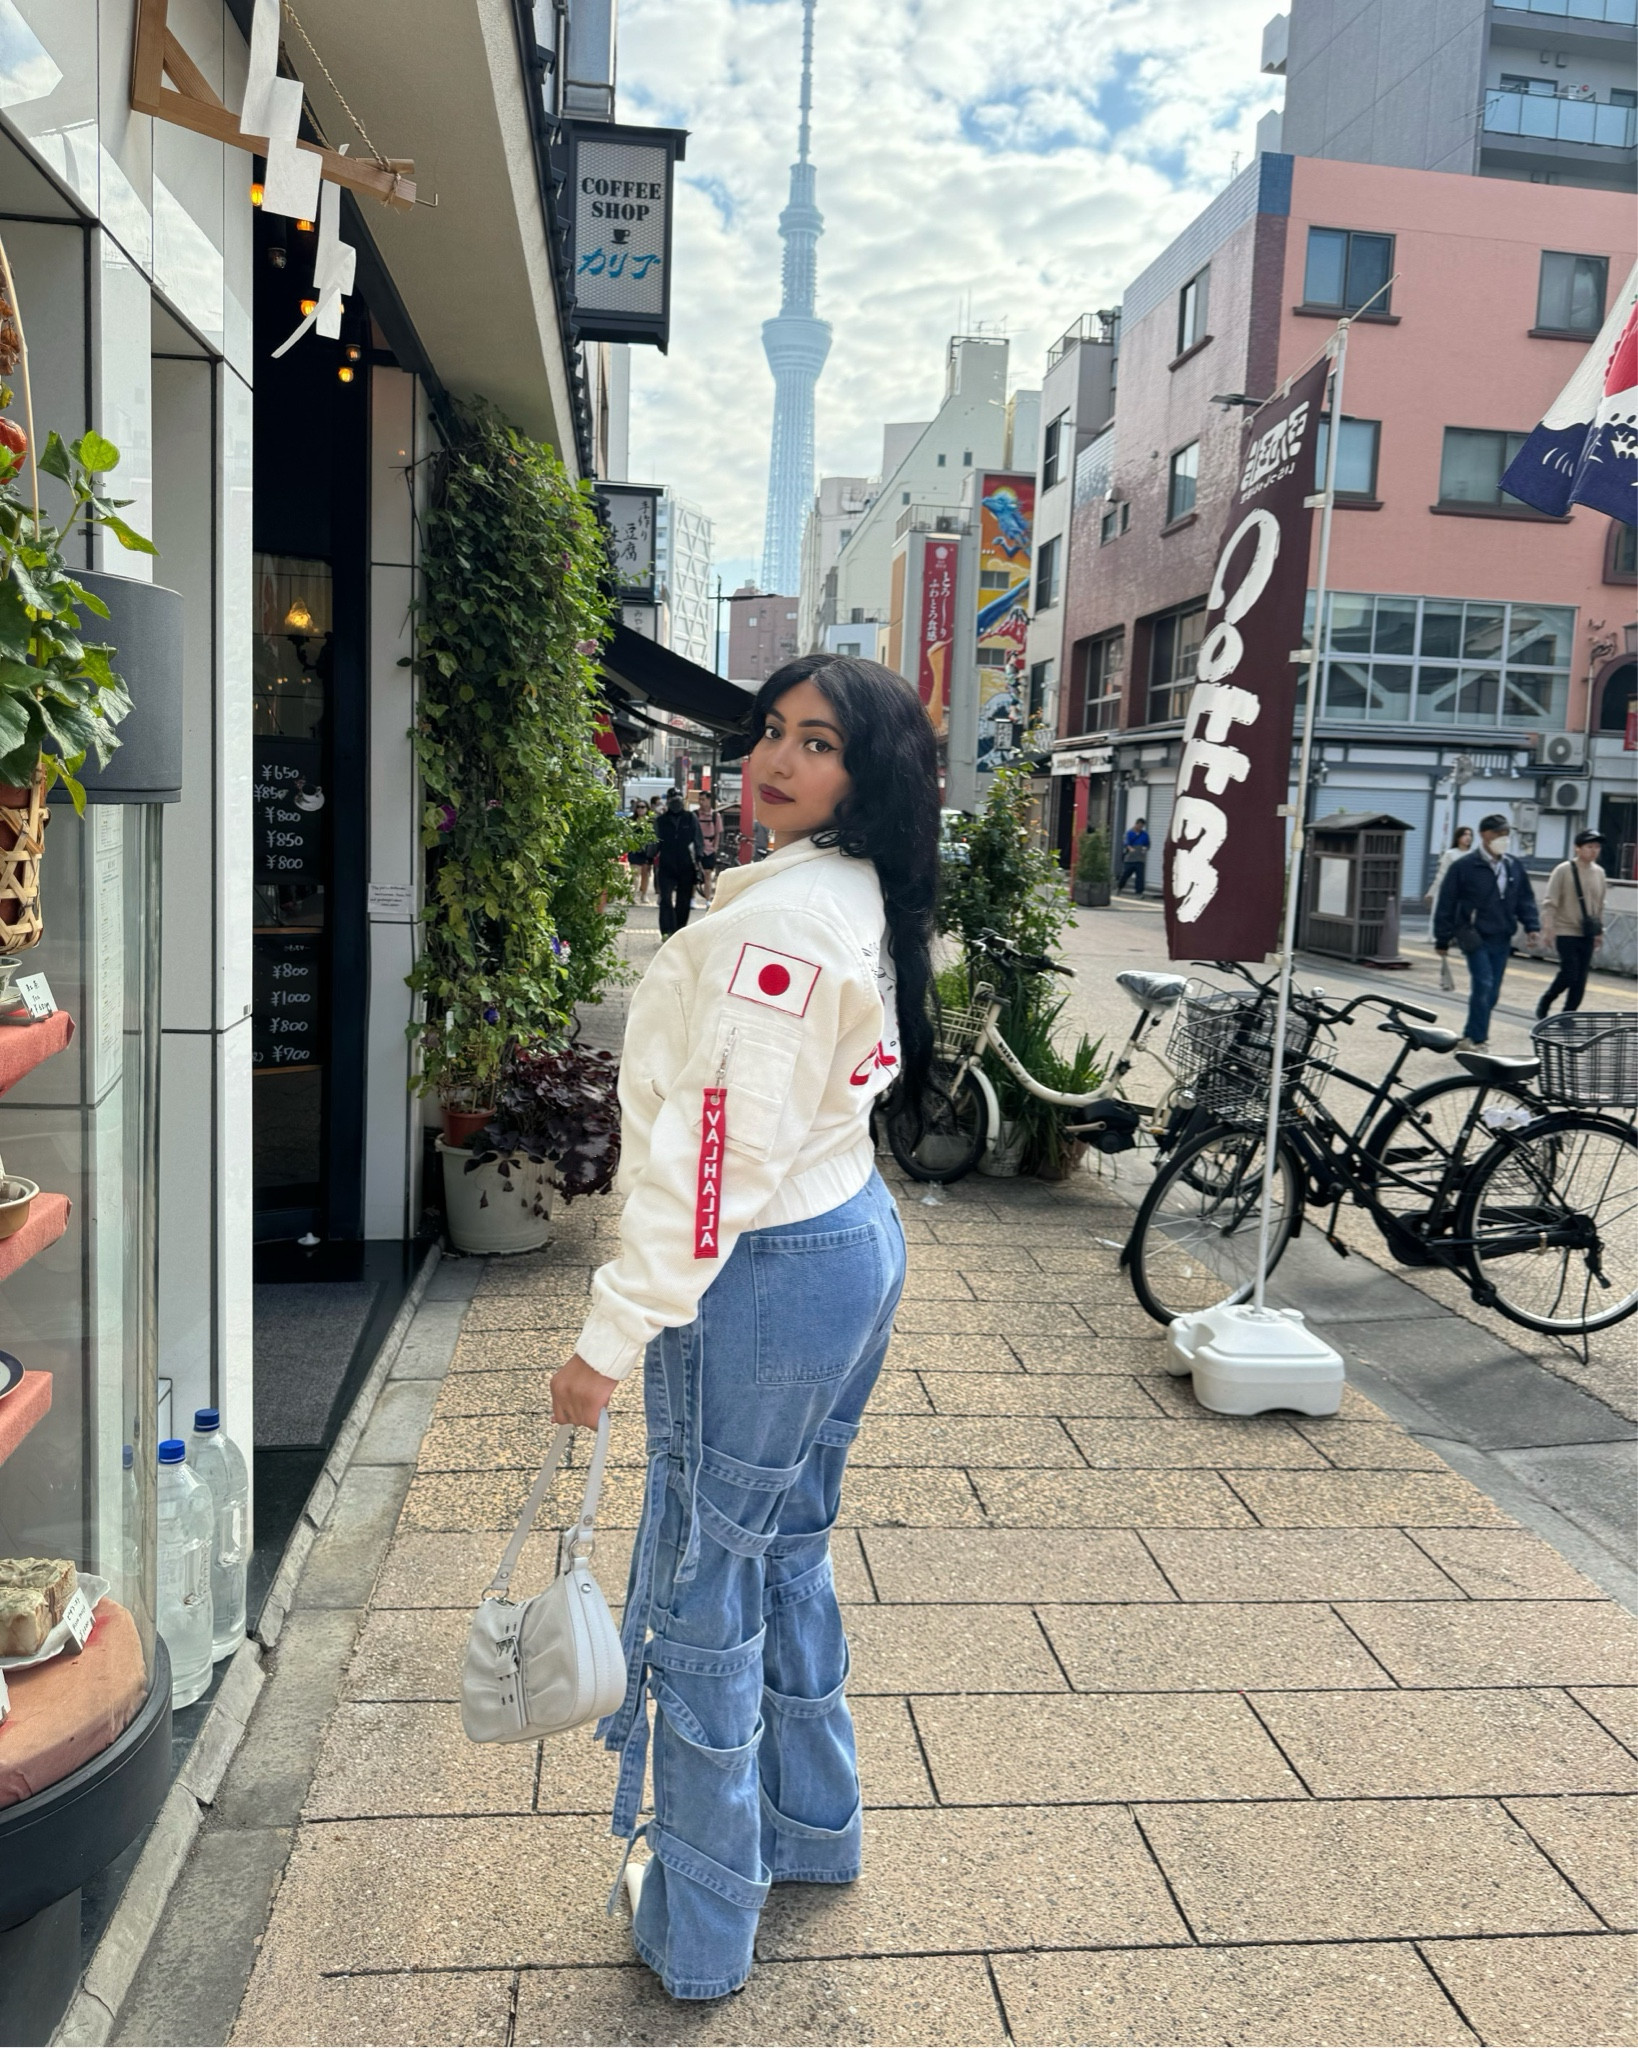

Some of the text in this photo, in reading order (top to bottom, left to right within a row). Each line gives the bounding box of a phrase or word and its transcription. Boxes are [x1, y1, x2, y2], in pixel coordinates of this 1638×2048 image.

[581, 177, 661, 200] COFFEE
[591, 201, 650, 221] SHOP
[621, 522, 639, 562] 豆腐
[262, 764, 299, 781] ¥650
[265, 806, 302, 824] ¥800
[266, 830, 304, 848] ¥850
[266, 854, 304, 870] ¥800
[272, 963, 309, 979] ¥800
[271, 990, 311, 1007] ¥1000
[269, 1017, 308, 1034] ¥800
[272, 1044, 310, 1063] ¥700
